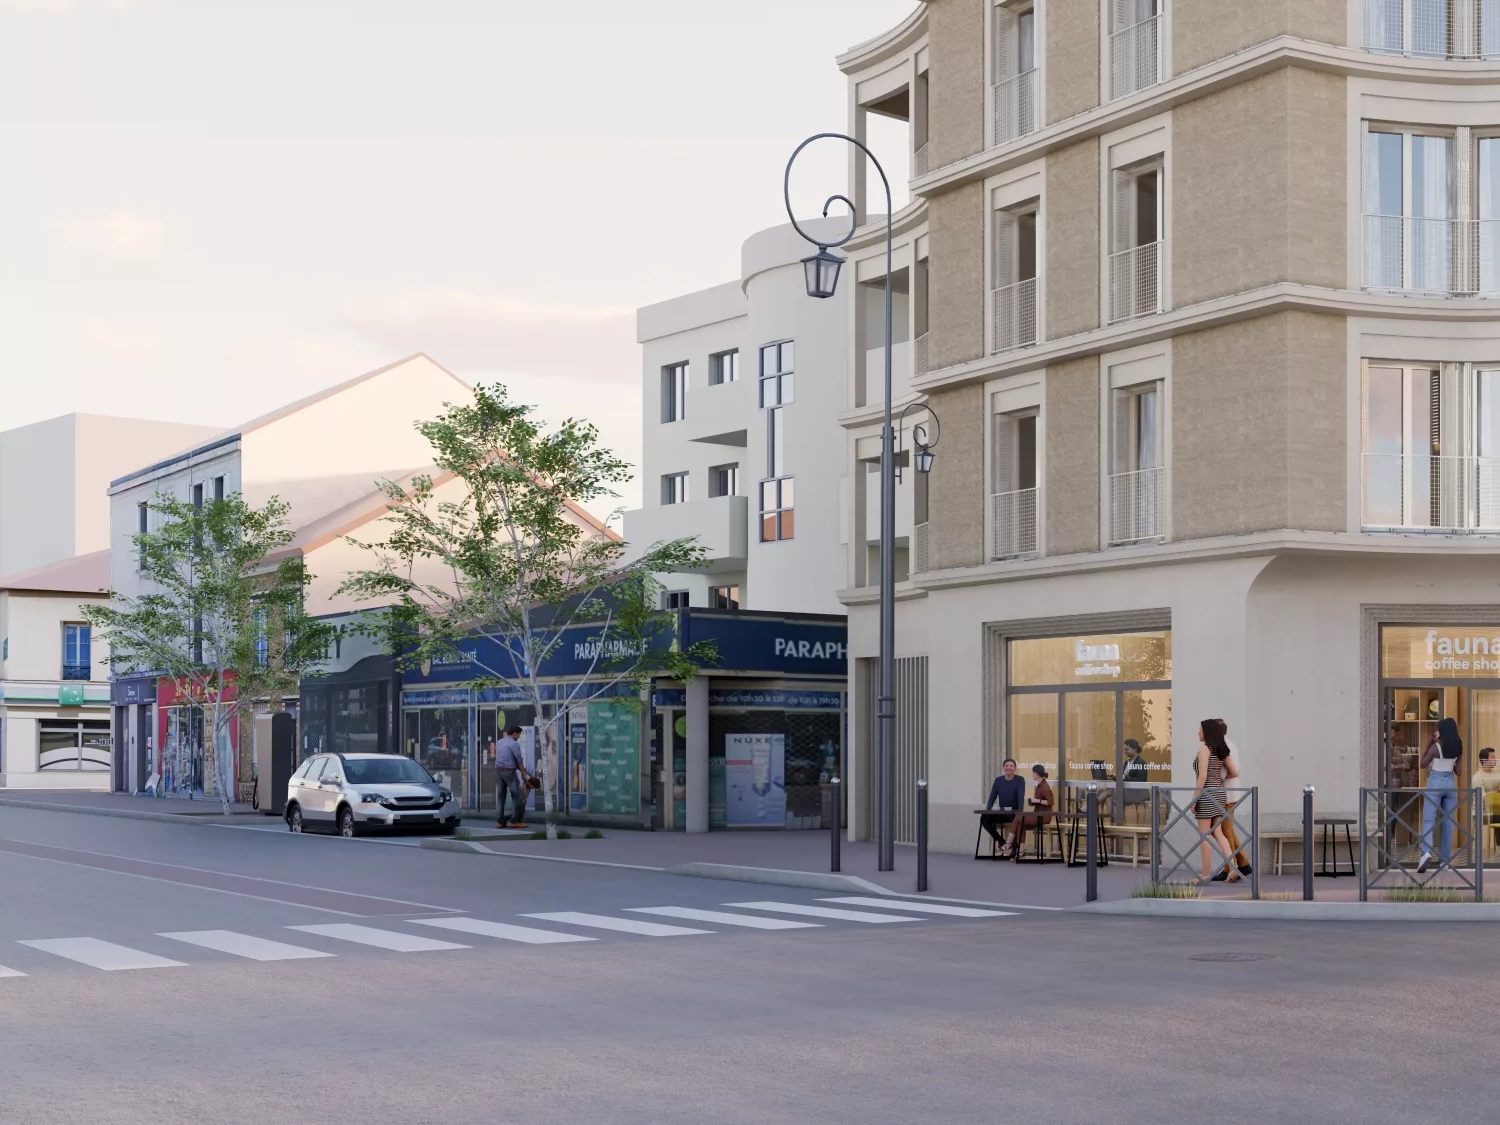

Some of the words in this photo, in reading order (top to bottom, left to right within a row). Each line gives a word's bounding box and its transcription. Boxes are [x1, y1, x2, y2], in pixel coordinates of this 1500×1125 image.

[574, 638, 649, 660] PARAPHARMACE
[774, 638, 848, 659] PARAPH
[1425, 657, 1470, 670] coffee
[1084, 761, 1100, 769] coffee
[1144, 761, 1160, 770] coffee
[1161, 761, 1172, 770] sho
